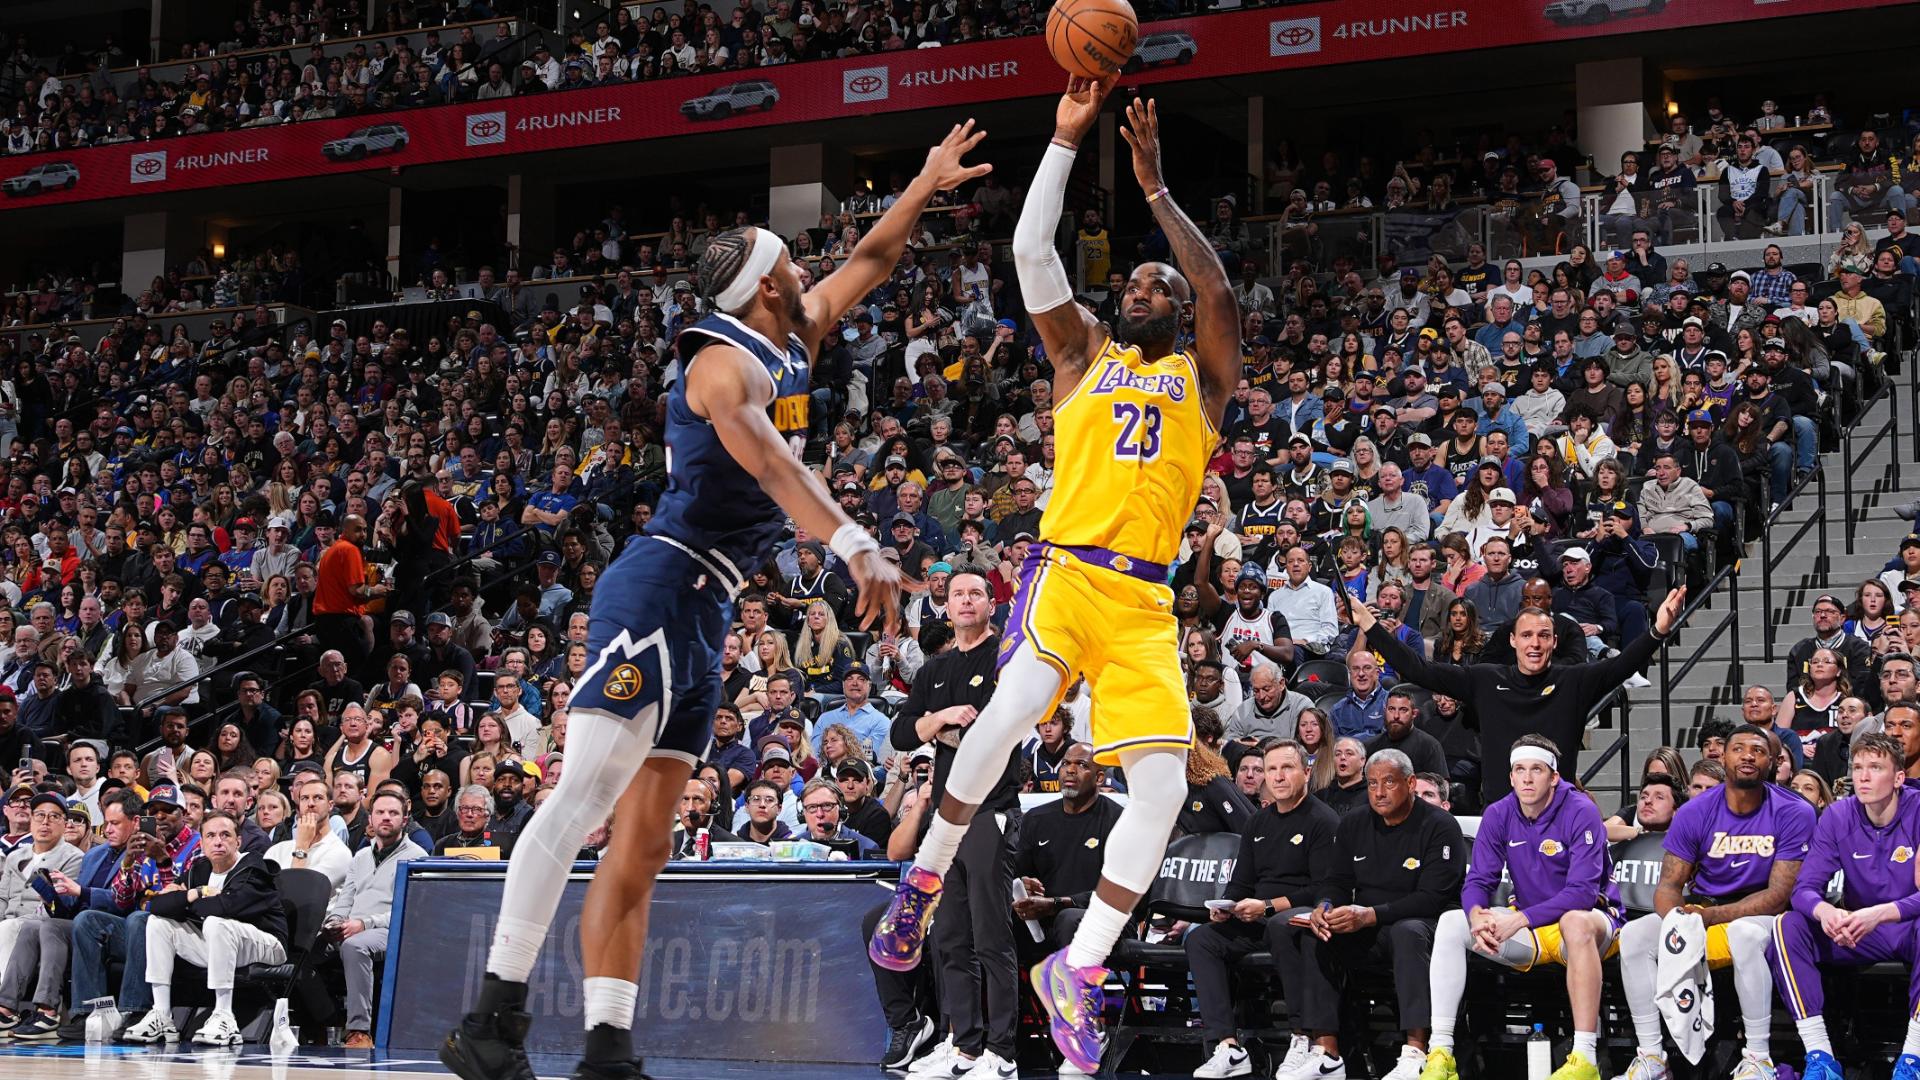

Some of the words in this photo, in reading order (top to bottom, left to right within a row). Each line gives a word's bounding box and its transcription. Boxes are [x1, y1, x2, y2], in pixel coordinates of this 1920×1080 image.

[1333, 13, 1467, 40] 4RUNNER
[899, 60, 1020, 88] 4RUNNER
[515, 106, 622, 132] 4RUNNER
[174, 147, 269, 171] 4RUNNER
[1087, 248, 1103, 260] 23
[1466, 282, 1478, 294] 15
[1090, 360, 1186, 403] LAKERS
[1253, 373, 1272, 386] NVER
[1112, 402, 1164, 463] 23
[1243, 525, 1276, 536] DENVER
[1233, 628, 1261, 642] USA
[329, 698, 343, 712] 27
[1040, 780, 1061, 792] DENV
[1706, 832, 1775, 858] LAKERS
[1160, 856, 1188, 880] GET
[1190, 858, 1218, 882] THE
[1613, 860, 1641, 884] GET
[1643, 861, 1666, 886] TH
[96, 1000, 114, 1009] UMB
